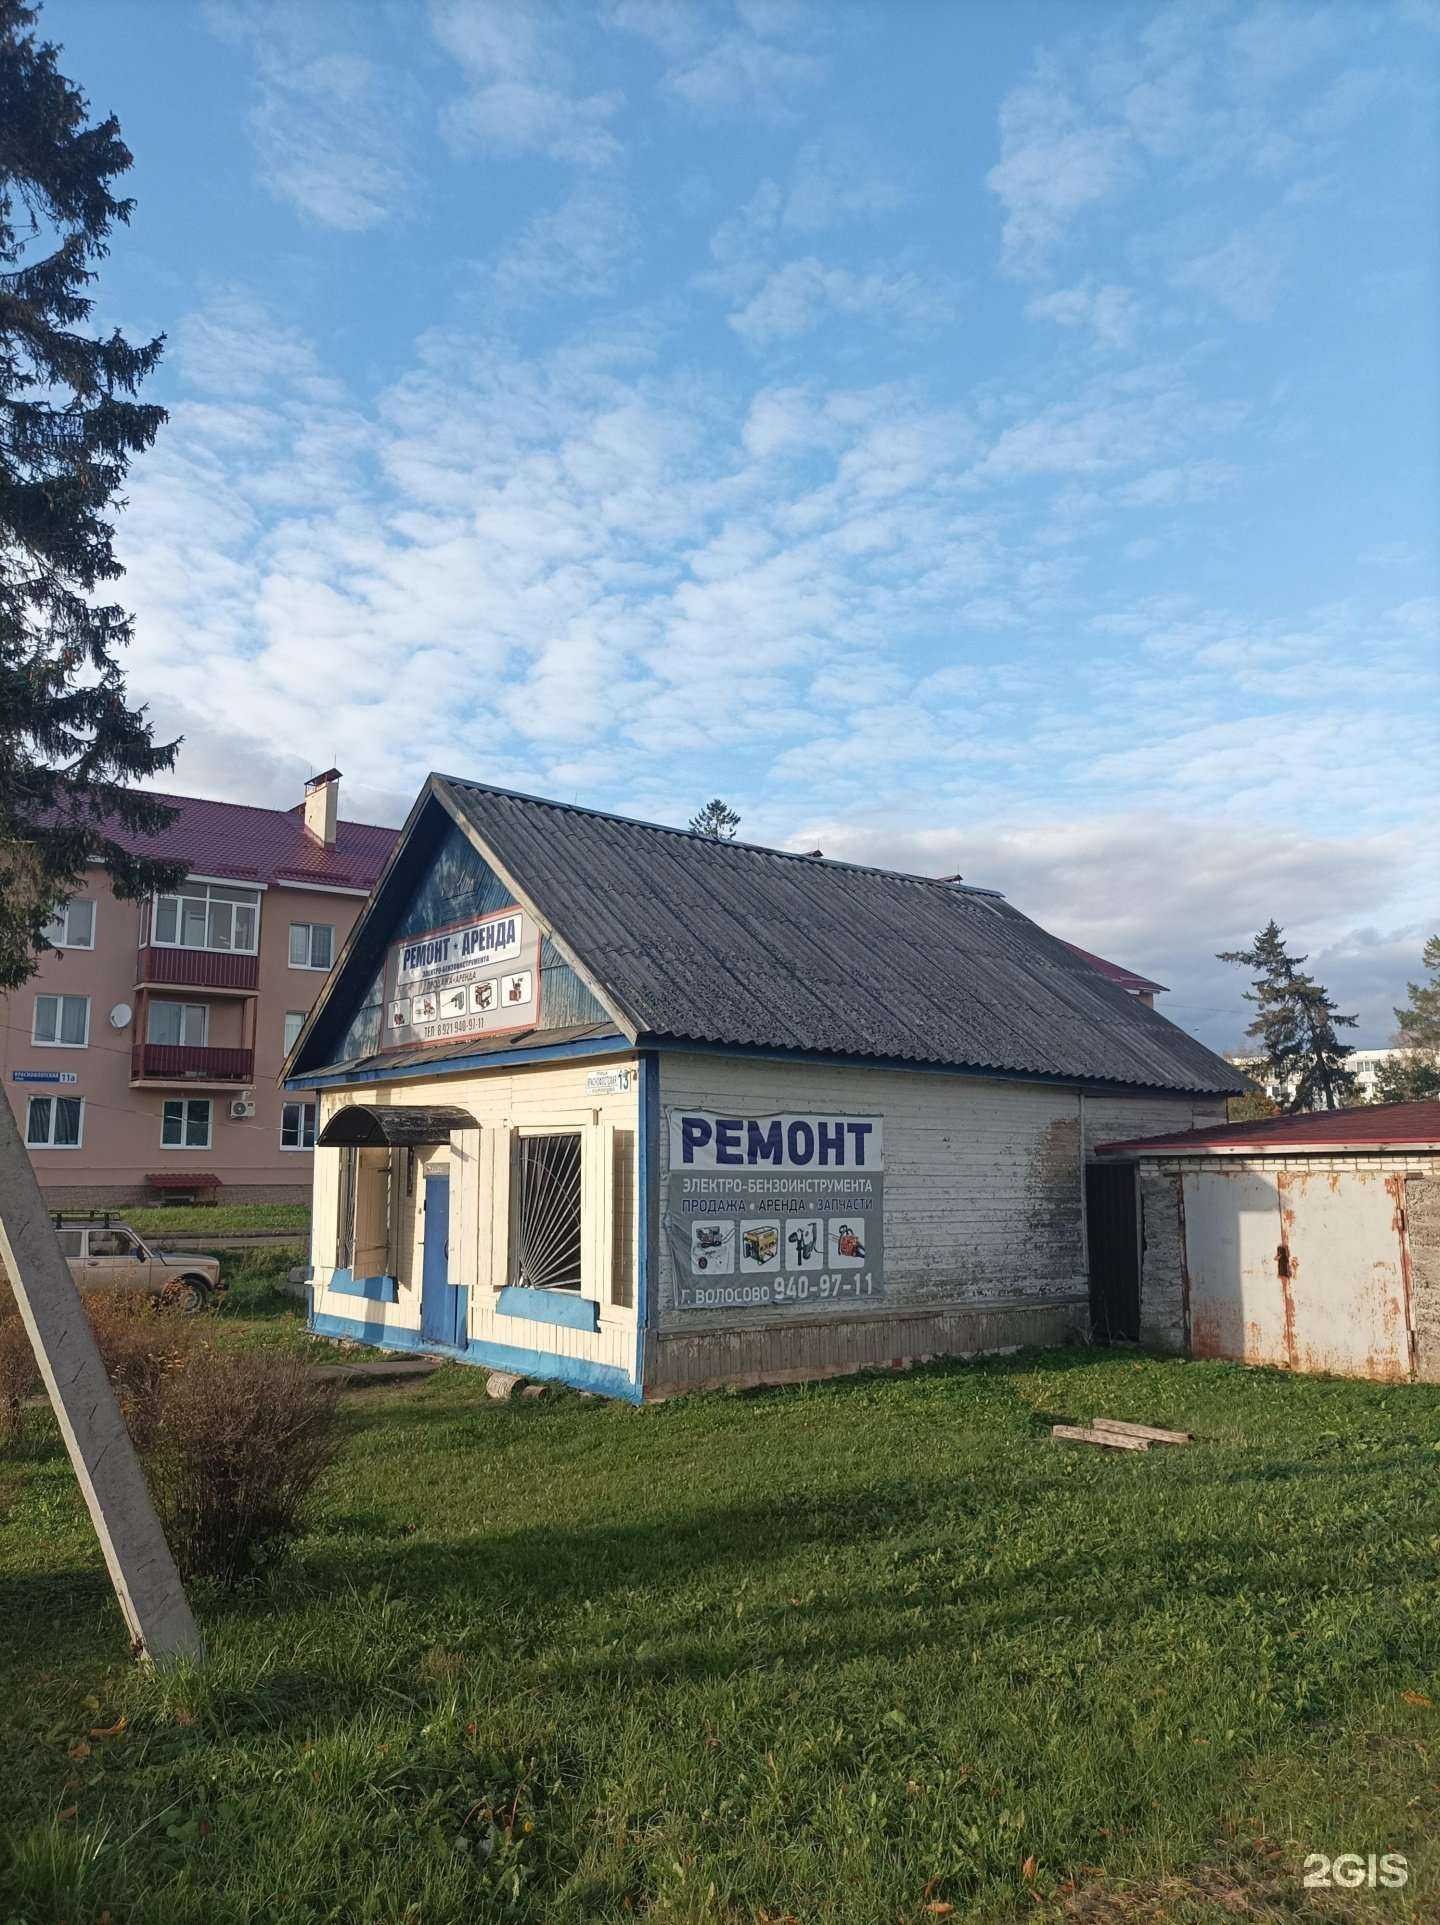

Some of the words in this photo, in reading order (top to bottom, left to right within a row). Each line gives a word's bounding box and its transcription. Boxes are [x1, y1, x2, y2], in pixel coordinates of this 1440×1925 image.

[403, 937, 450, 971] РЕМОНТ
[461, 919, 516, 956] АРЕНДА
[618, 1069, 629, 1090] 13
[682, 1117, 872, 1166] РЕМОНТ
[682, 1178, 873, 1193] ЭЛЕКТРО-БЕНЗОИНСТРУМЕНТА
[681, 1199, 746, 1214] ПРОДАЖА
[758, 1198, 806, 1213] АРЕНДА
[817, 1198, 873, 1210] ЗАПЧАСТИ
[695, 1286, 770, 1304] ВОЛОСОВО
[774, 1273, 873, 1299] 940-97-11
